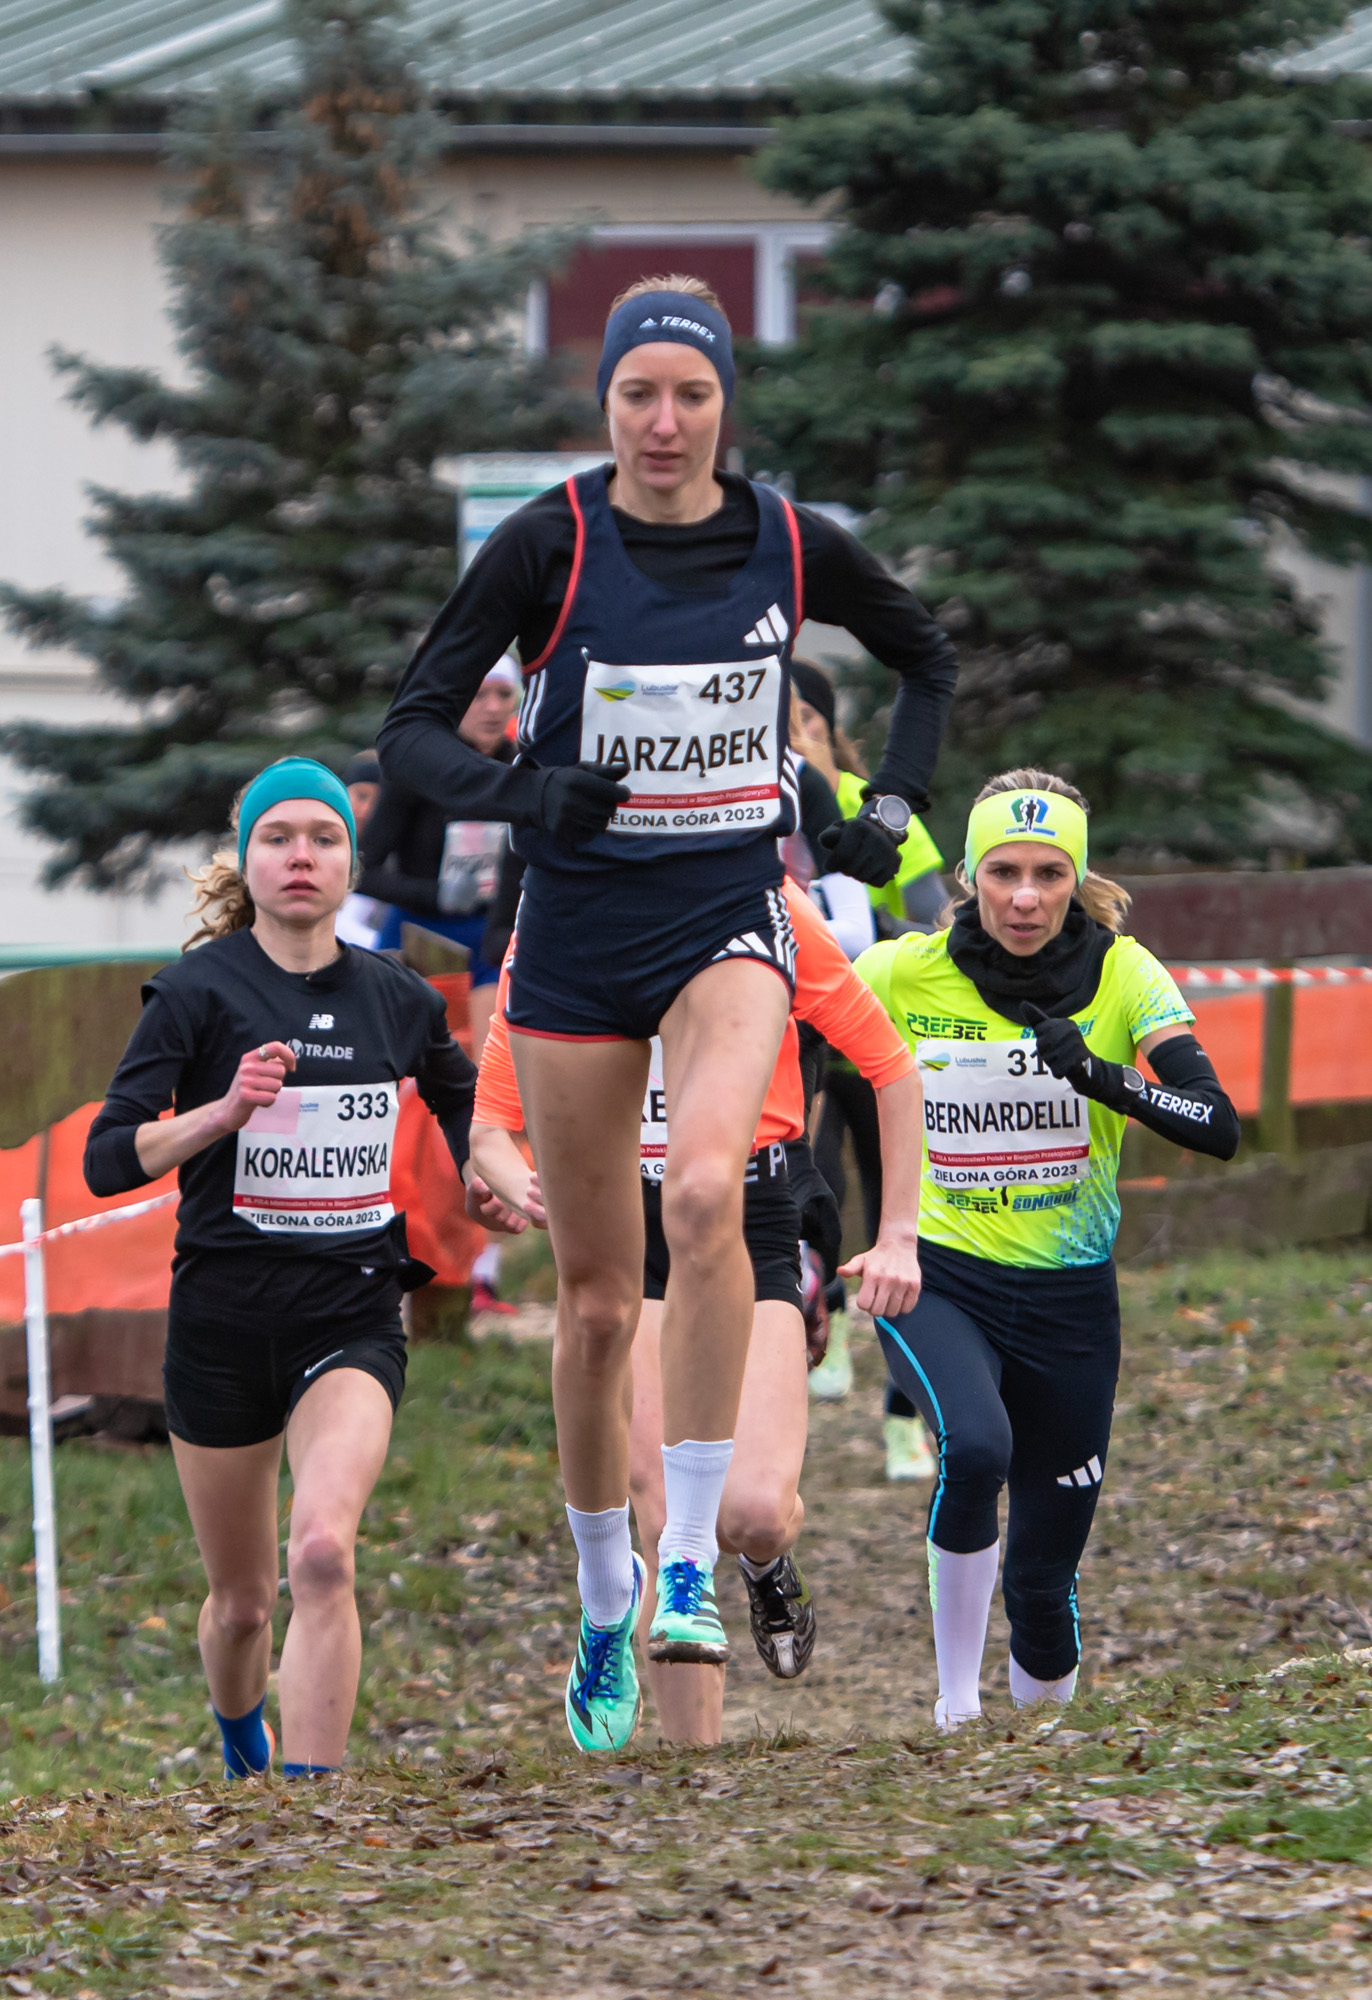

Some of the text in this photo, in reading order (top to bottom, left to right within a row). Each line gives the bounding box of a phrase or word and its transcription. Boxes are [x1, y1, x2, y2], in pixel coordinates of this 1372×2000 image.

[661, 315, 716, 343] TERREX
[698, 668, 767, 704] 437
[596, 724, 769, 778] JARZĄBEK
[610, 806, 766, 827] ELONA GÓRA 2023
[304, 1043, 354, 1060] TRADE
[1007, 1048, 1049, 1077] 31
[336, 1091, 389, 1121] 333
[924, 1097, 1081, 1134] BERNARDELLI
[1149, 1087, 1214, 1125] TERREX
[244, 1142, 388, 1179] KORALEWSKA
[934, 1164, 1077, 1183] ZIELONA GÓRA 2023
[313, 1212, 353, 1227] GÓRA
[355, 1210, 382, 1225] 2023
